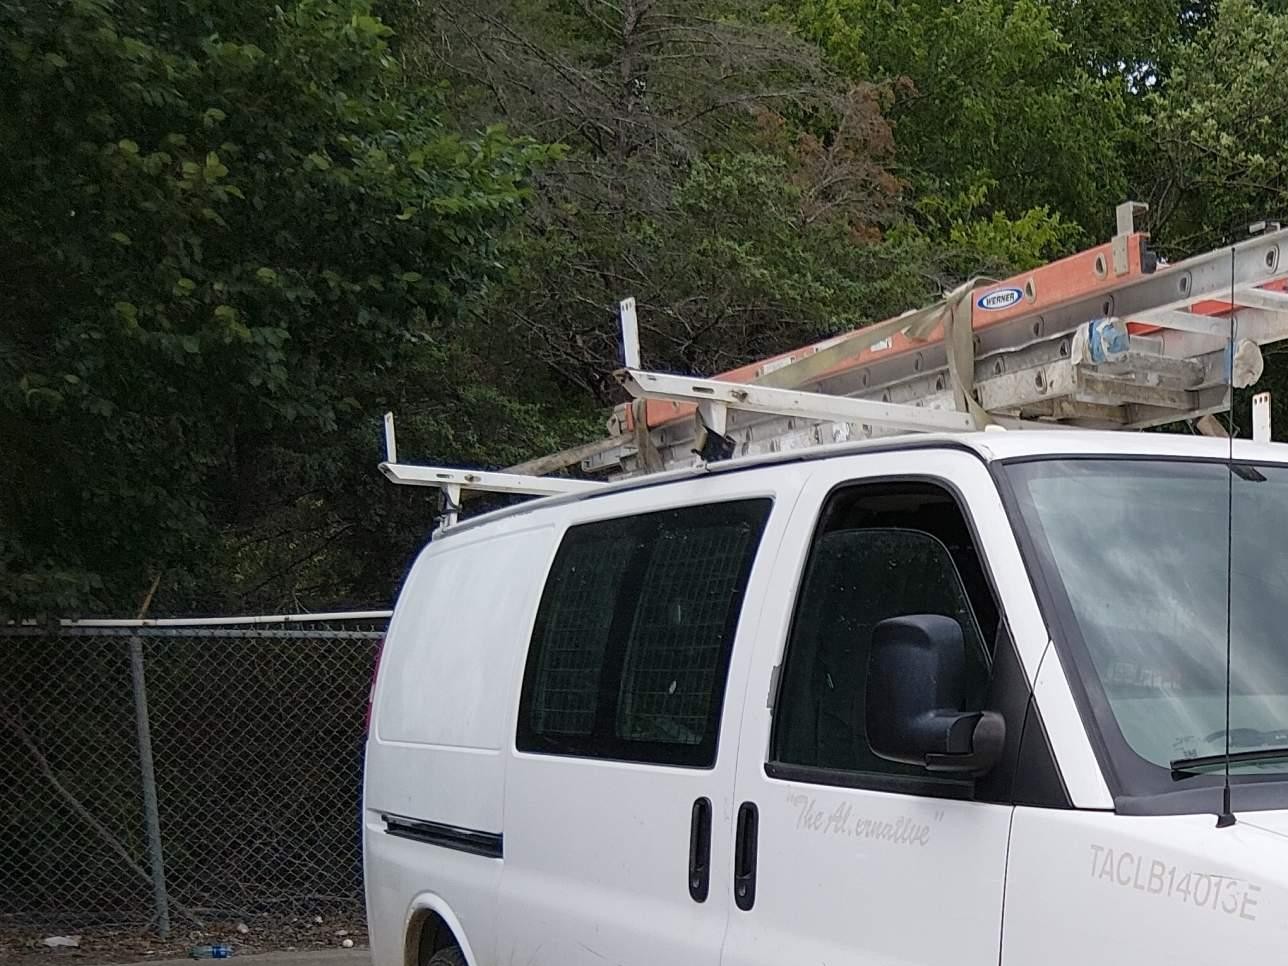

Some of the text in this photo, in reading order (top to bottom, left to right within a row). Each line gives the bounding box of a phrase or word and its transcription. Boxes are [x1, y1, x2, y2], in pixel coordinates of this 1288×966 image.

[985, 292, 1015, 306] WERNER
[824, 800, 945, 847] Alernative"
[1090, 844, 1262, 921] TACLB14013E
